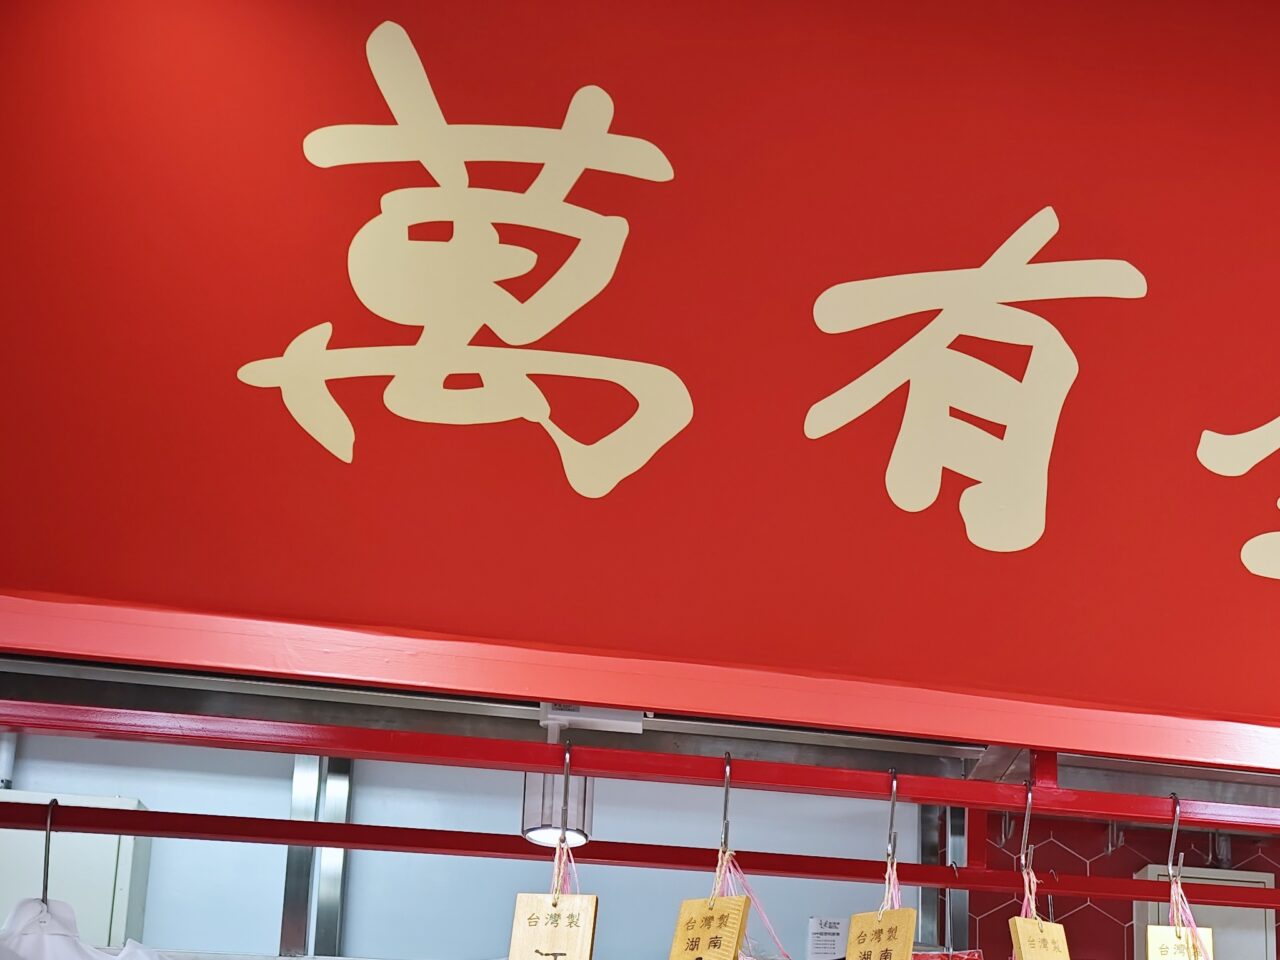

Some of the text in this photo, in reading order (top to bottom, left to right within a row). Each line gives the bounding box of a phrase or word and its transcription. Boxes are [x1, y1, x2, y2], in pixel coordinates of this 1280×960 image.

[527, 912, 580, 928] 台灣製
[685, 913, 730, 931] 台灣製
[685, 935, 722, 951] 湖南
[856, 926, 898, 944] 台灣製
